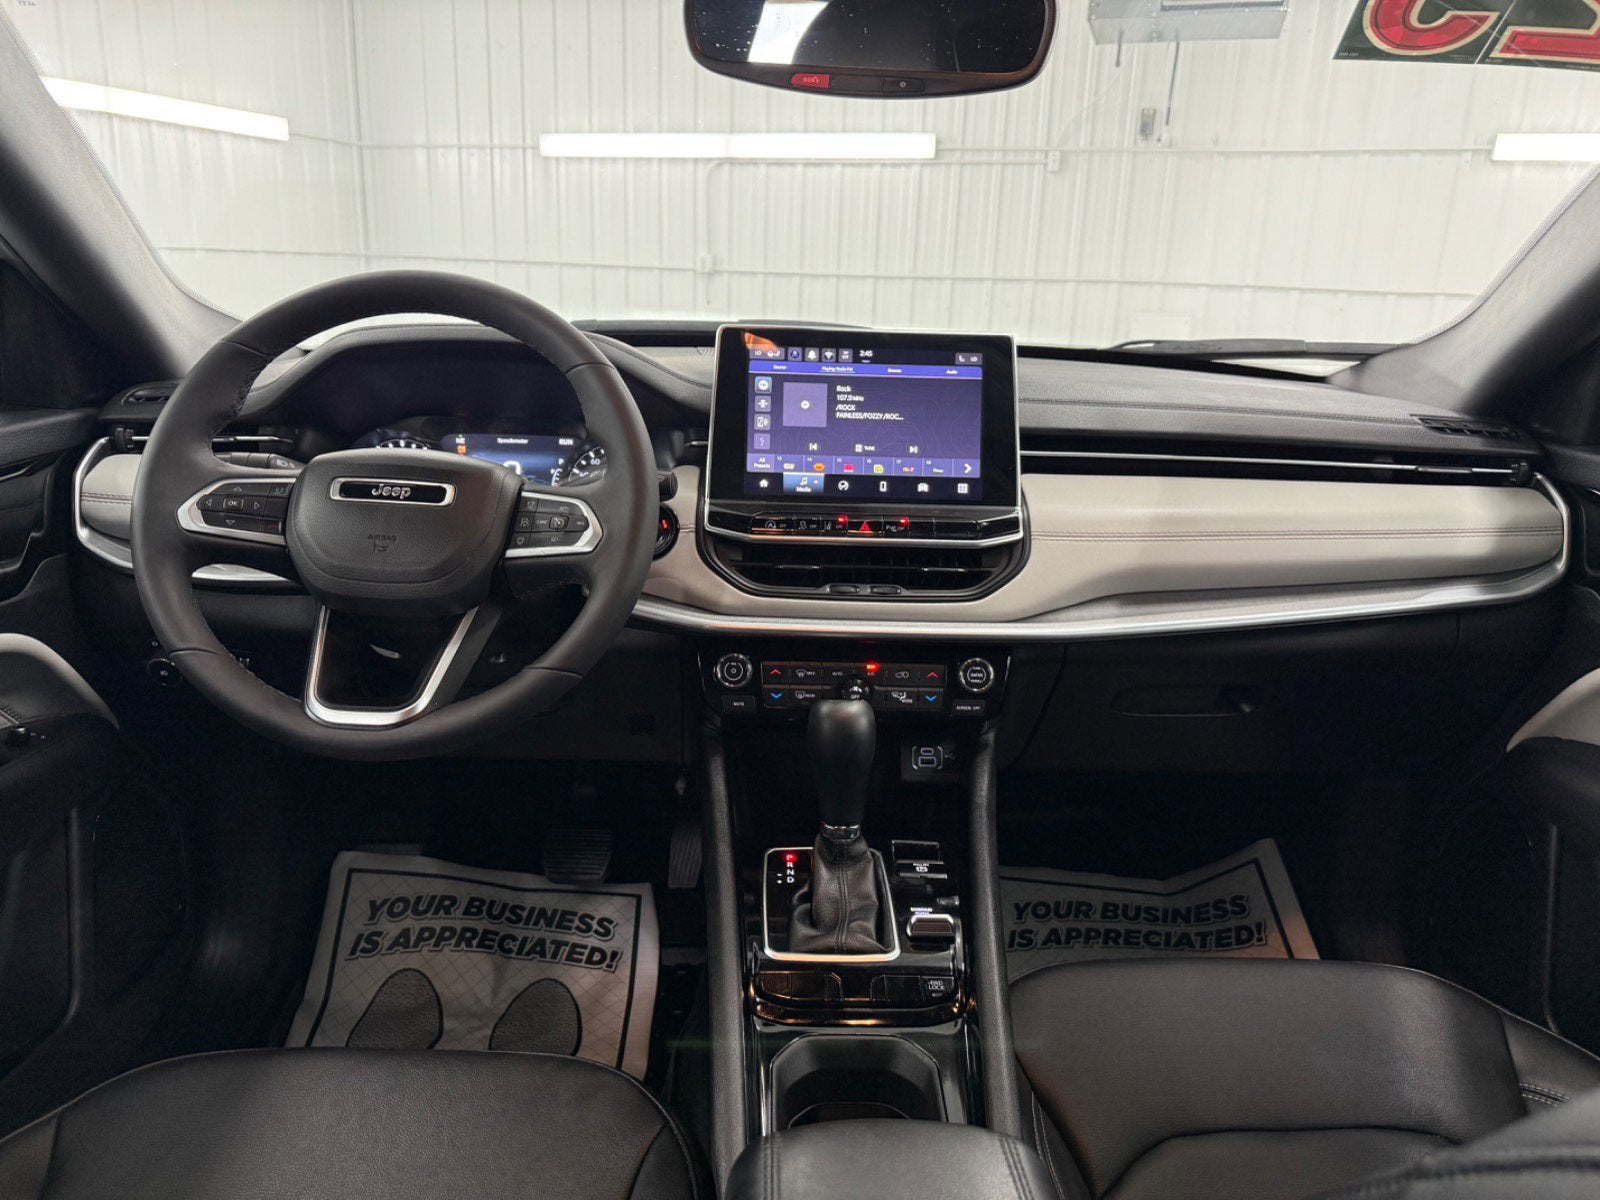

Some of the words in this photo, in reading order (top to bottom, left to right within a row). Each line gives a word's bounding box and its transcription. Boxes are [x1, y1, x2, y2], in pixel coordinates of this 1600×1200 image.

[559, 438, 574, 446] RUN
[371, 483, 412, 499] Jeep
[367, 534, 397, 542] AIRBAG
[366, 895, 459, 923] YOUR
[462, 897, 617, 939] BUSINESS
[1012, 901, 1096, 922] YOUR
[1101, 895, 1248, 924] BUSINESS
[349, 931, 385, 958] IS
[385, 927, 622, 971] APPRECIATED!
[1007, 929, 1038, 949] IS
[1041, 921, 1266, 949] APPRECIATED!
